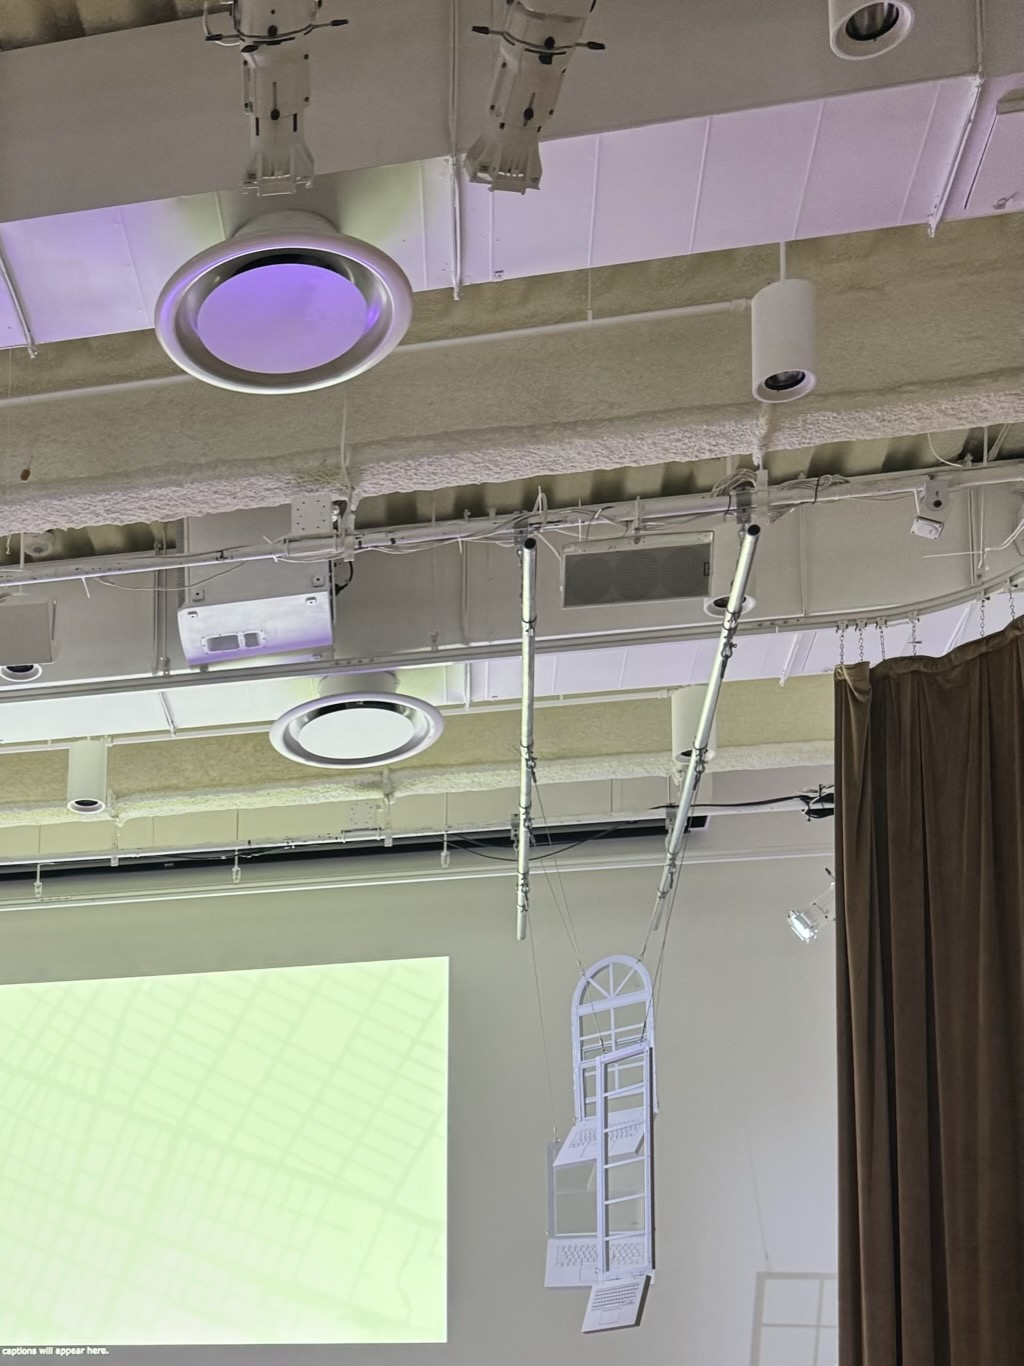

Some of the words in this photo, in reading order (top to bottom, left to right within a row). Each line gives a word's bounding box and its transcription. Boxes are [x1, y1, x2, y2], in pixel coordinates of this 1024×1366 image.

[2, 1346, 37, 1356] captions
[38, 1346, 54, 1355] will
[55, 1346, 86, 1356] appear
[87, 1346, 109, 1355] here.
